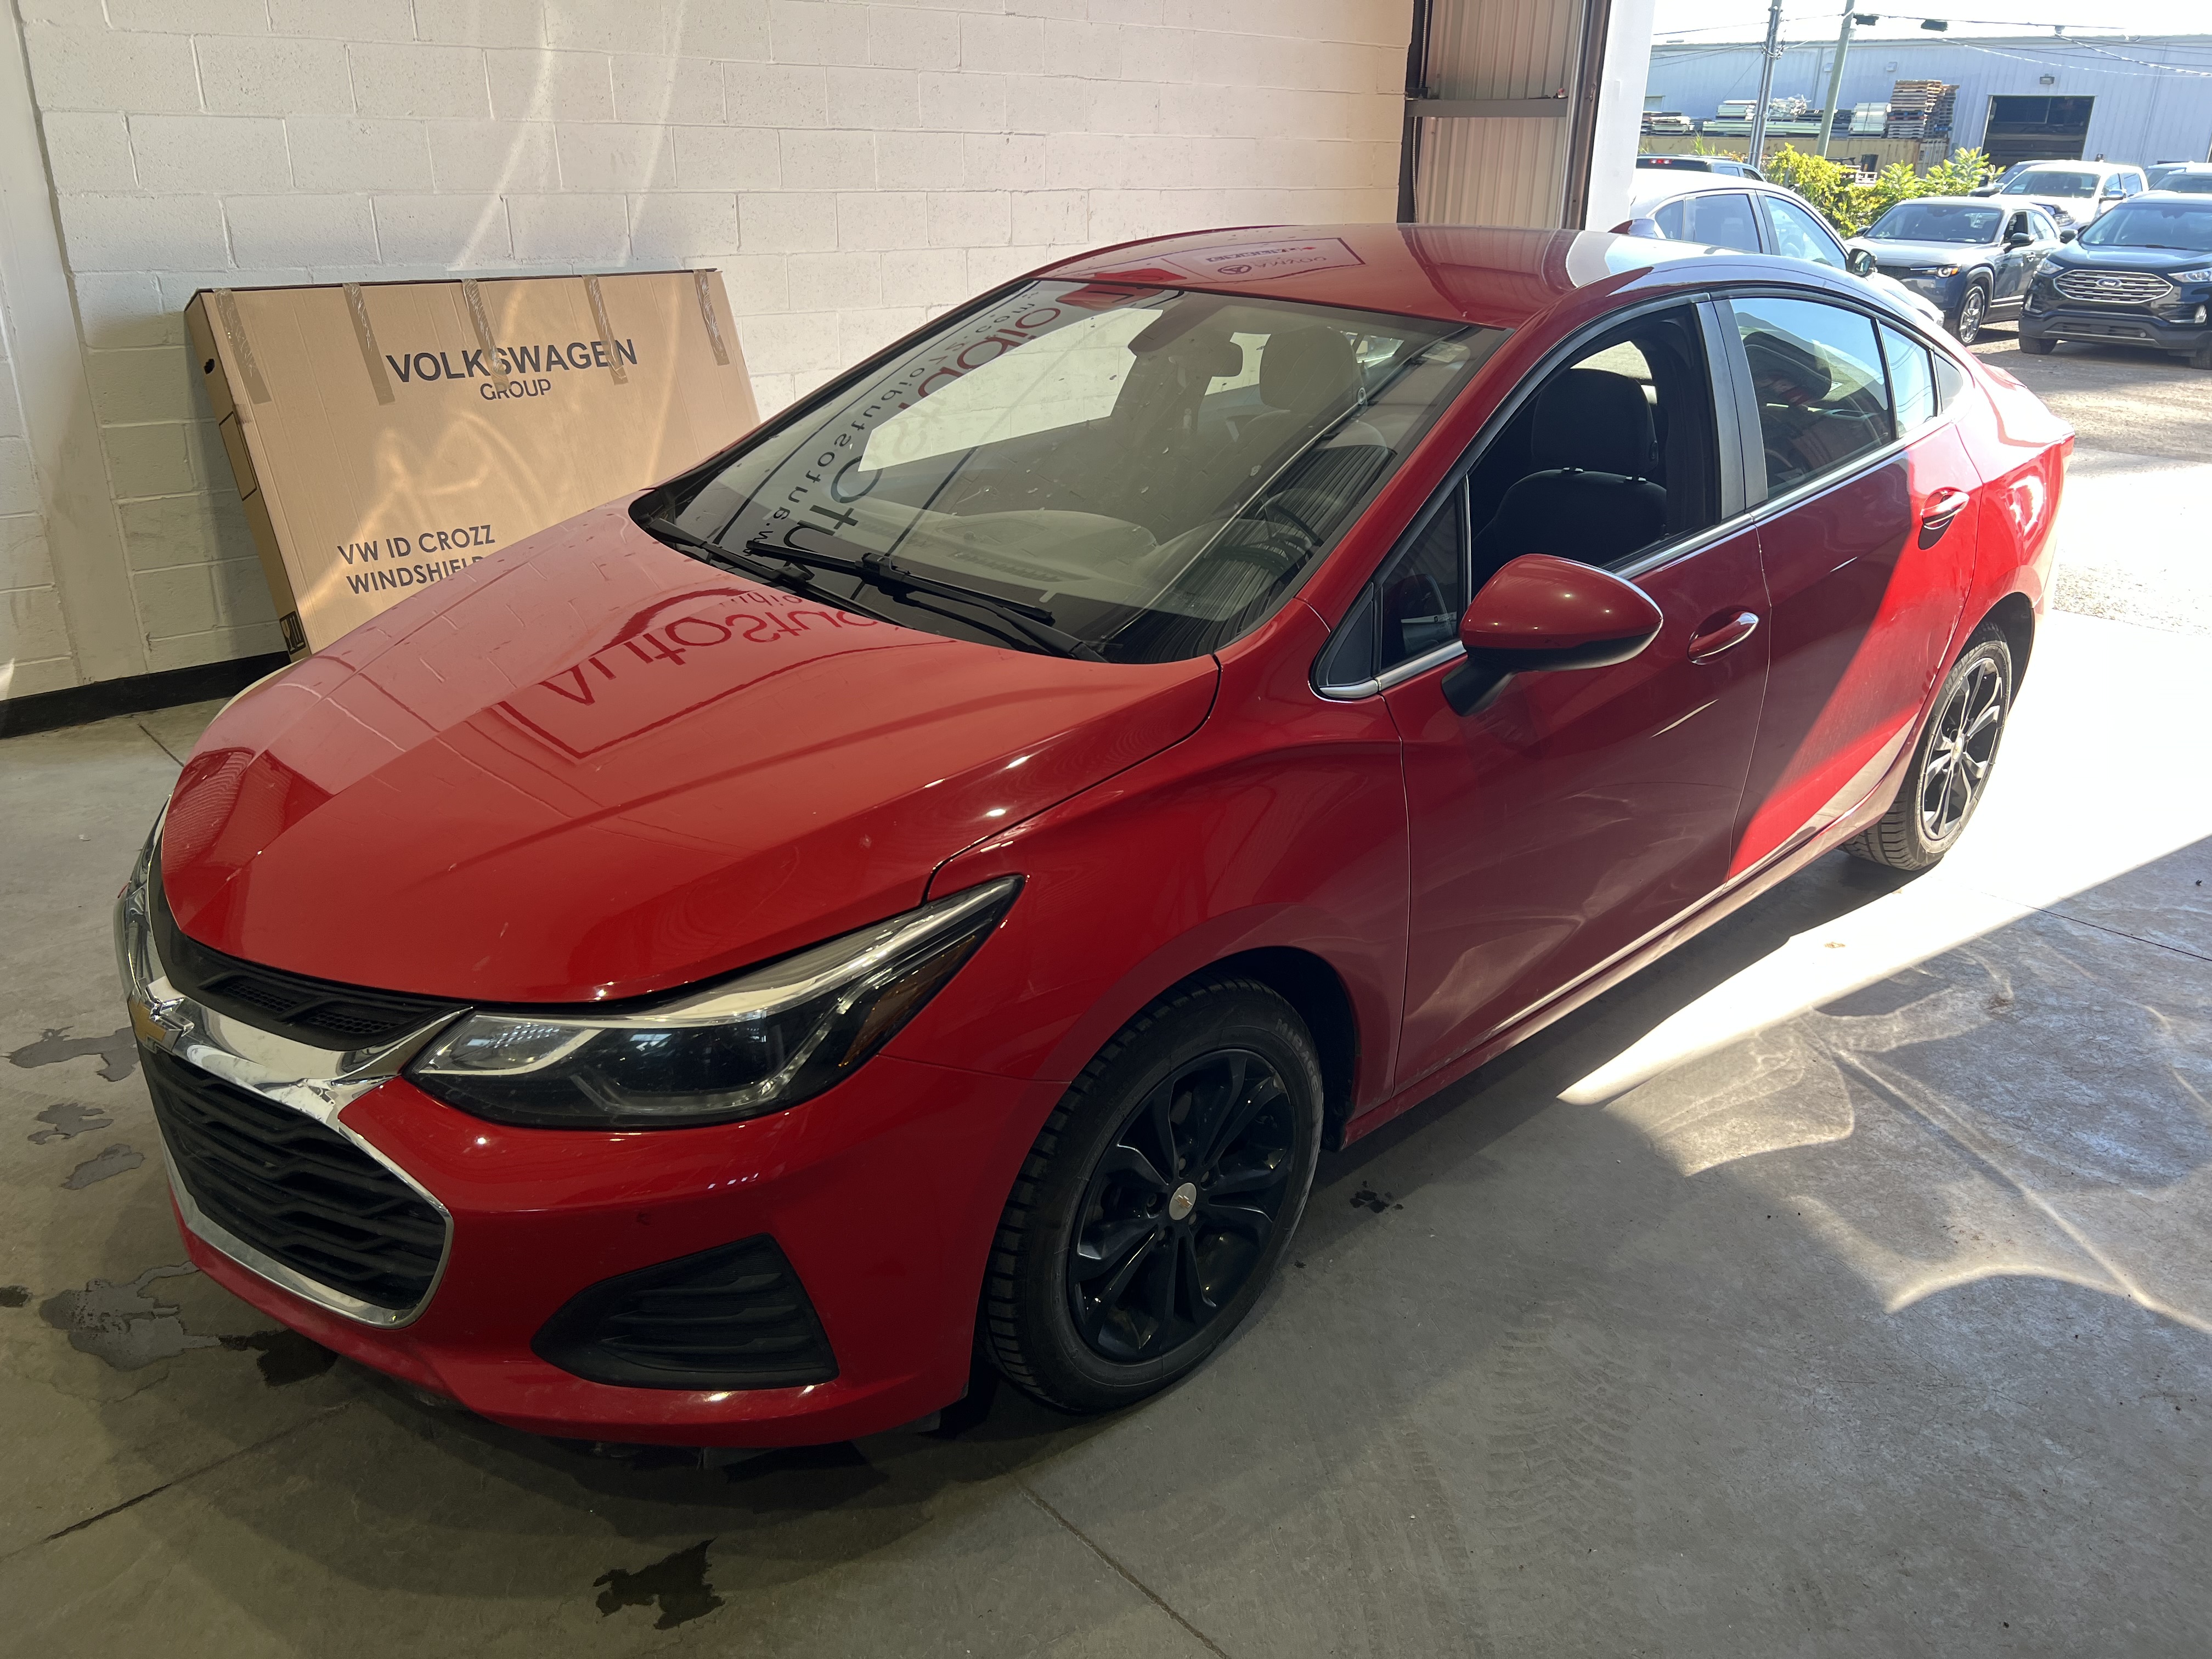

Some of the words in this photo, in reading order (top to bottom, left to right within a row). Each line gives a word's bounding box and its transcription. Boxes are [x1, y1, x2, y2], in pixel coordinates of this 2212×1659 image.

[386, 338, 637, 383] VOLKSWAGEN
[480, 379, 551, 400] GROUP
[337, 540, 379, 565] VW
[386, 537, 411, 558] ID
[419, 524, 495, 552] CROZZ
[1274, 1018, 1318, 1093] MIRAGE
